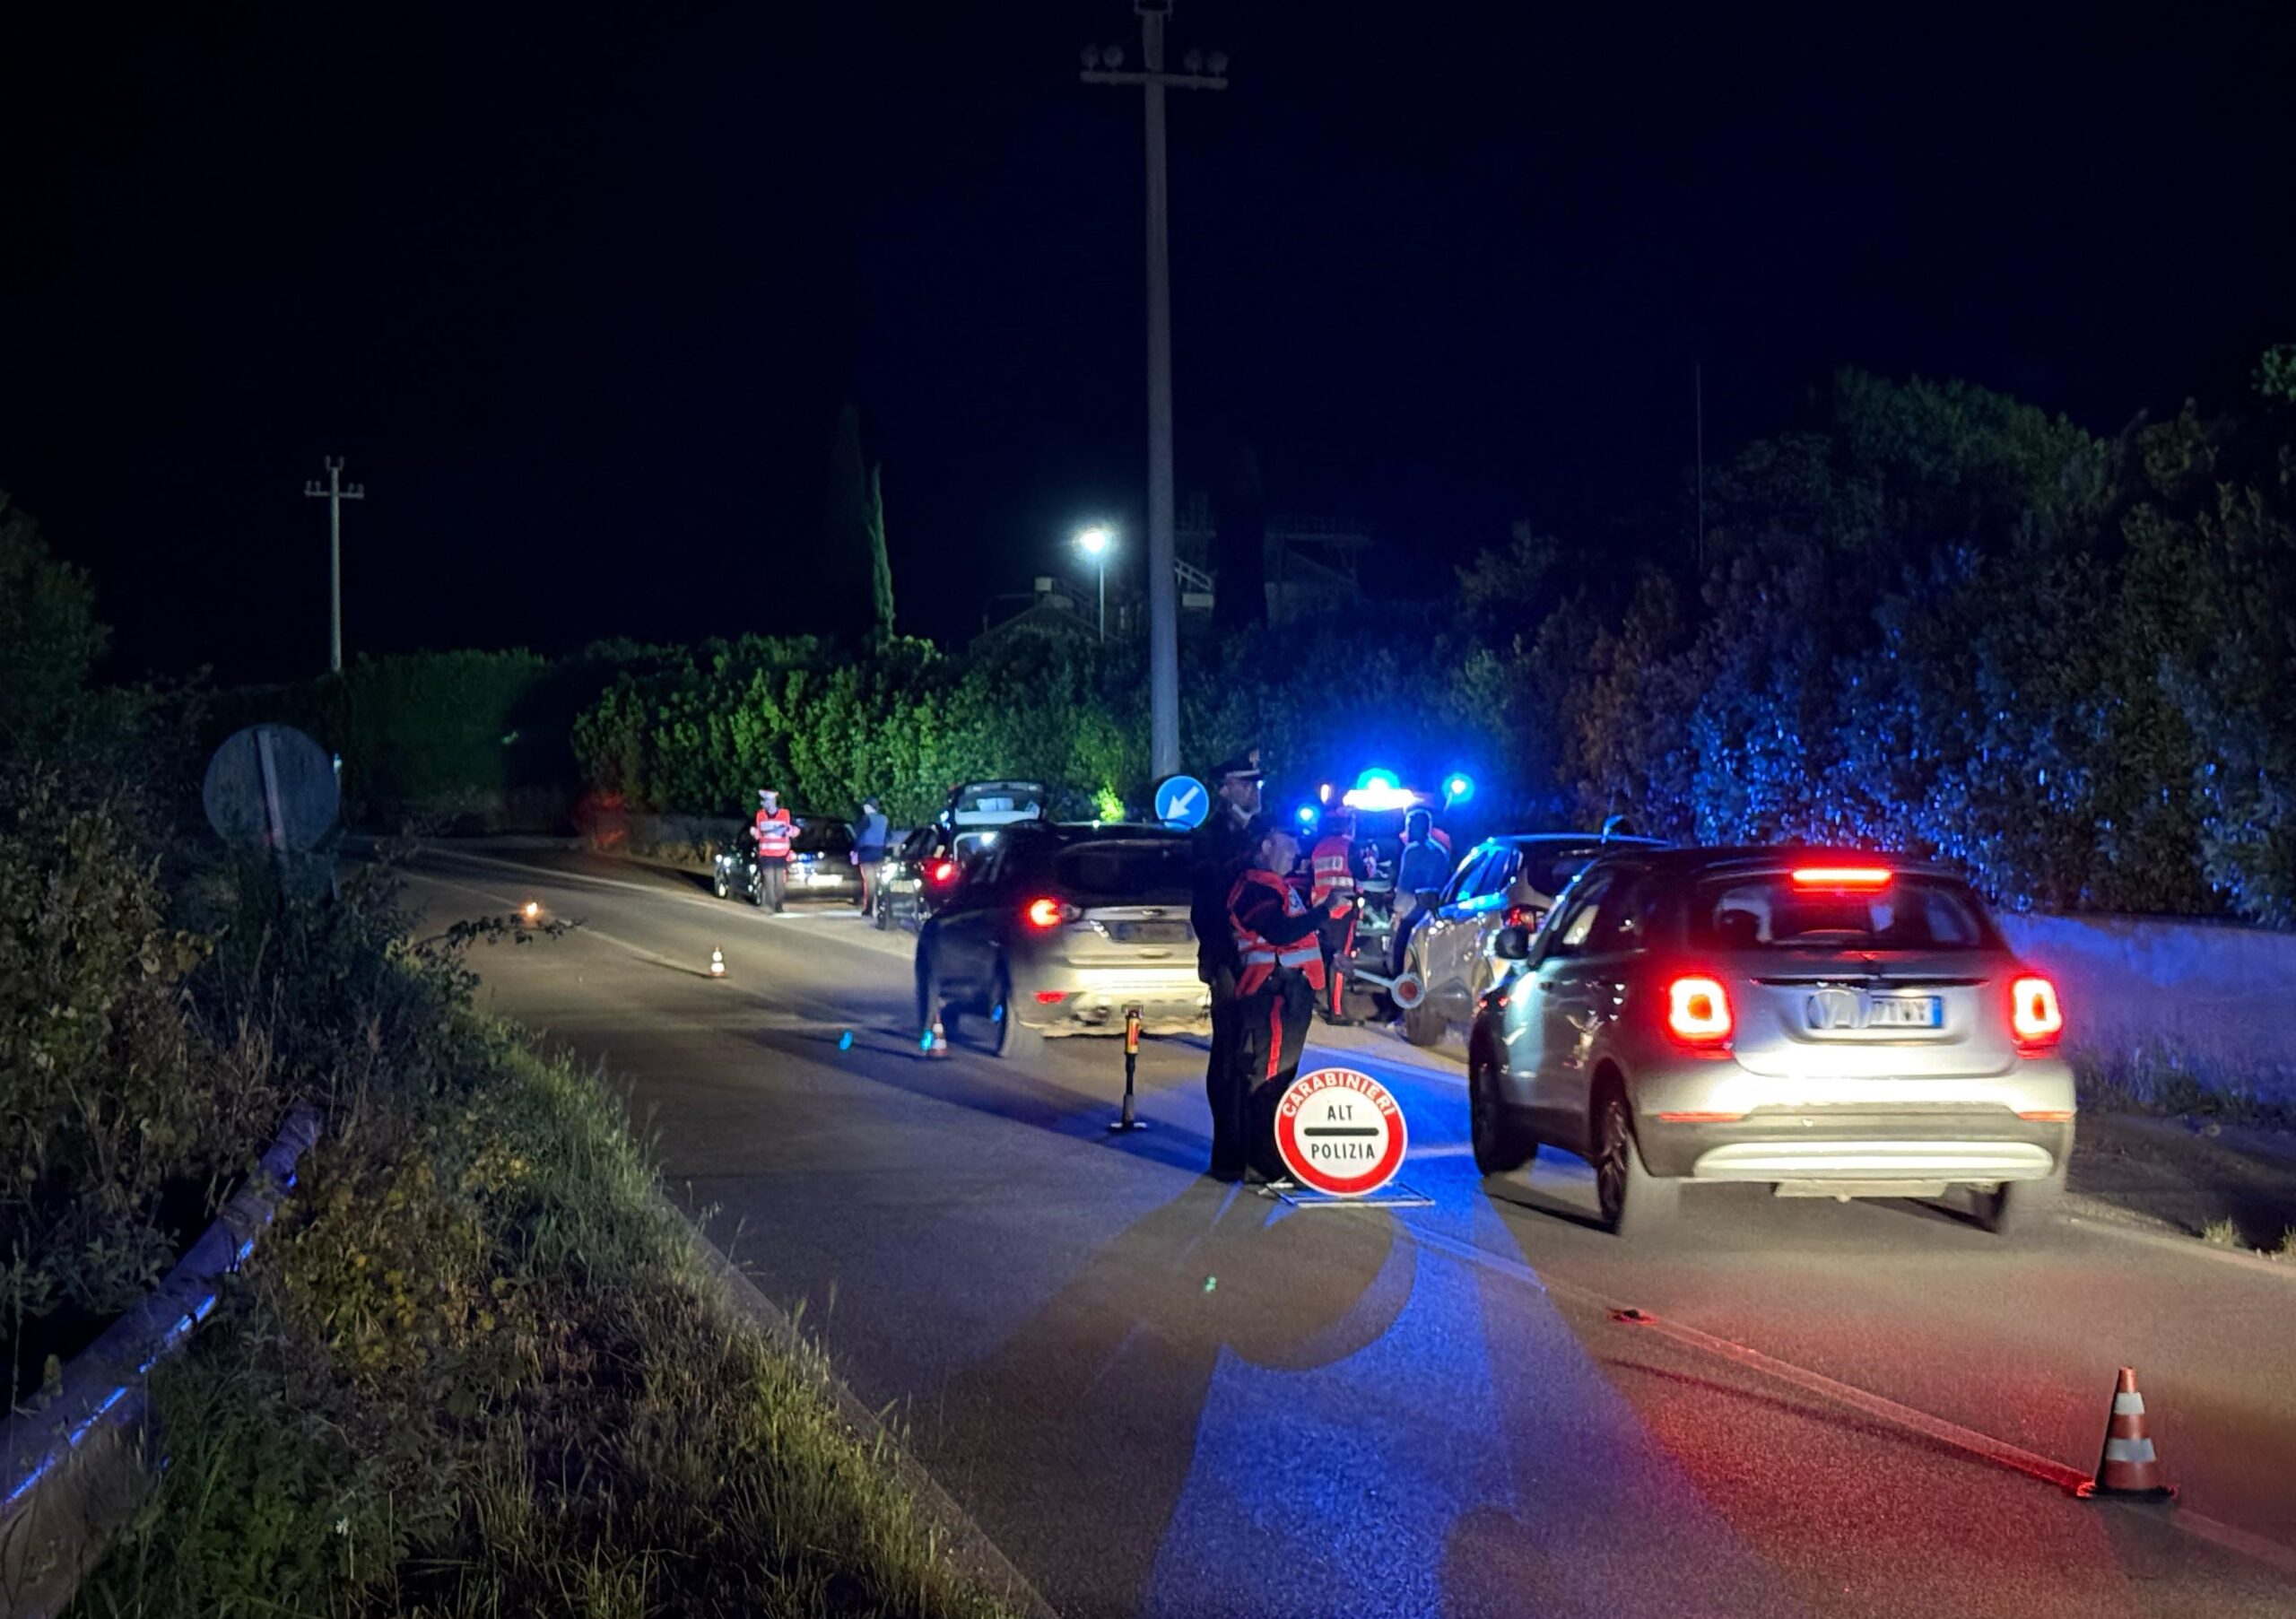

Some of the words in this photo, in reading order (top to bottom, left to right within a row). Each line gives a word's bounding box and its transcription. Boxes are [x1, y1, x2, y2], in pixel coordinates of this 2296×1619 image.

[1283, 1072, 1396, 1118] CARABINIERI
[1327, 1104, 1352, 1120] ALT
[1311, 1144, 1375, 1159] POLIZIA
